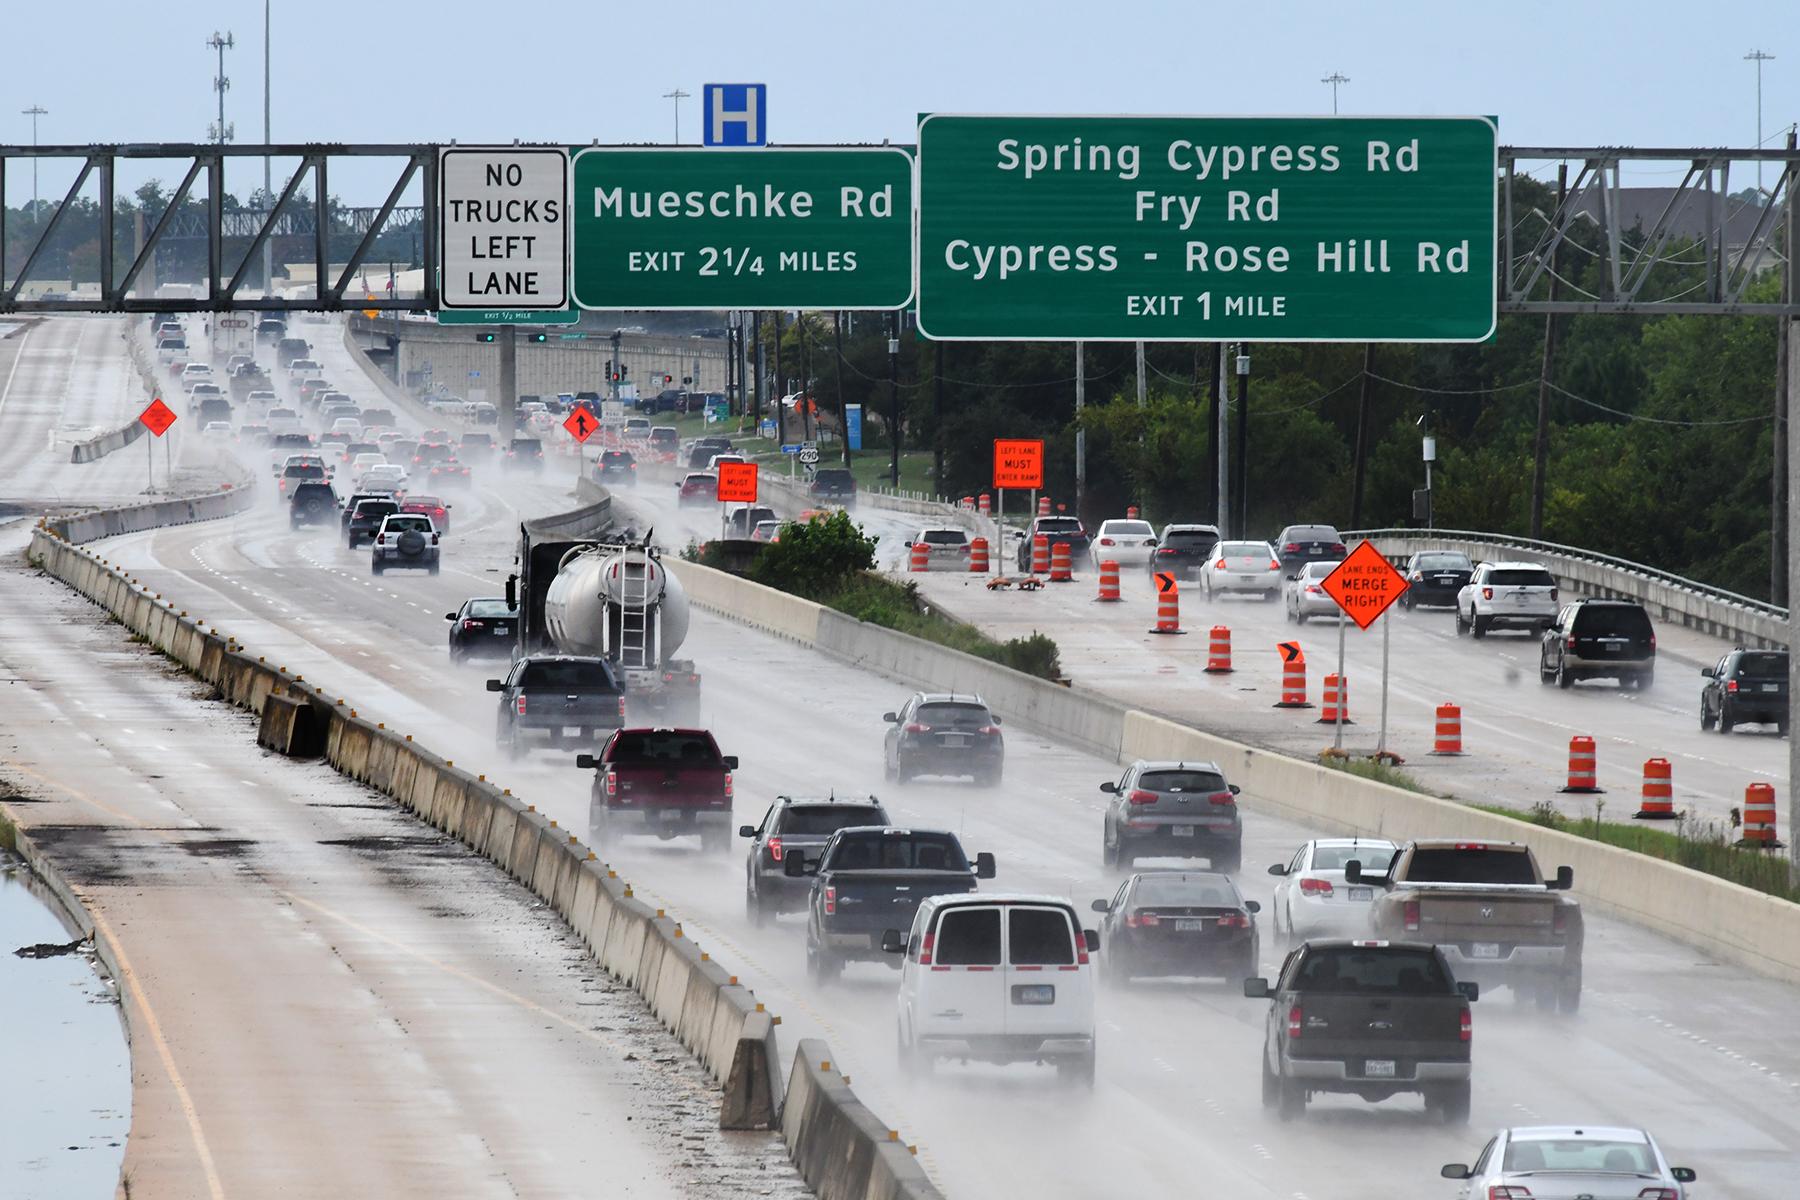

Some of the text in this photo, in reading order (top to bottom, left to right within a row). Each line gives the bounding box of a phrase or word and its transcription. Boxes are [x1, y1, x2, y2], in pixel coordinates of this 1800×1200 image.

[712, 87, 758, 144] H
[997, 137, 1419, 181] Spring Cypress Rd
[486, 163, 523, 187] NO
[449, 199, 560, 224] TRUCKS
[594, 184, 892, 218] Mueschke Rd
[1136, 188, 1279, 231] Fry Rd
[471, 235, 537, 259] LEFT
[629, 251, 685, 272] EXIT
[779, 251, 857, 272] MILES
[944, 239, 1118, 280] Cypress
[1186, 240, 1290, 273] Rose
[1317, 239, 1391, 273] Hill
[1418, 239, 1469, 274] Rd
[468, 271, 539, 295] LANE
[1127, 291, 1286, 321] EXIT 1 MILE
[801, 451, 817, 460] 290
[1000, 447, 1036, 455] LEFT LANE
[1004, 459, 1032, 469] MUST
[1343, 566, 1388, 575] LANE ENDS
[1341, 578, 1389, 591] MERGE
[1344, 595, 1385, 607] RIGHT
